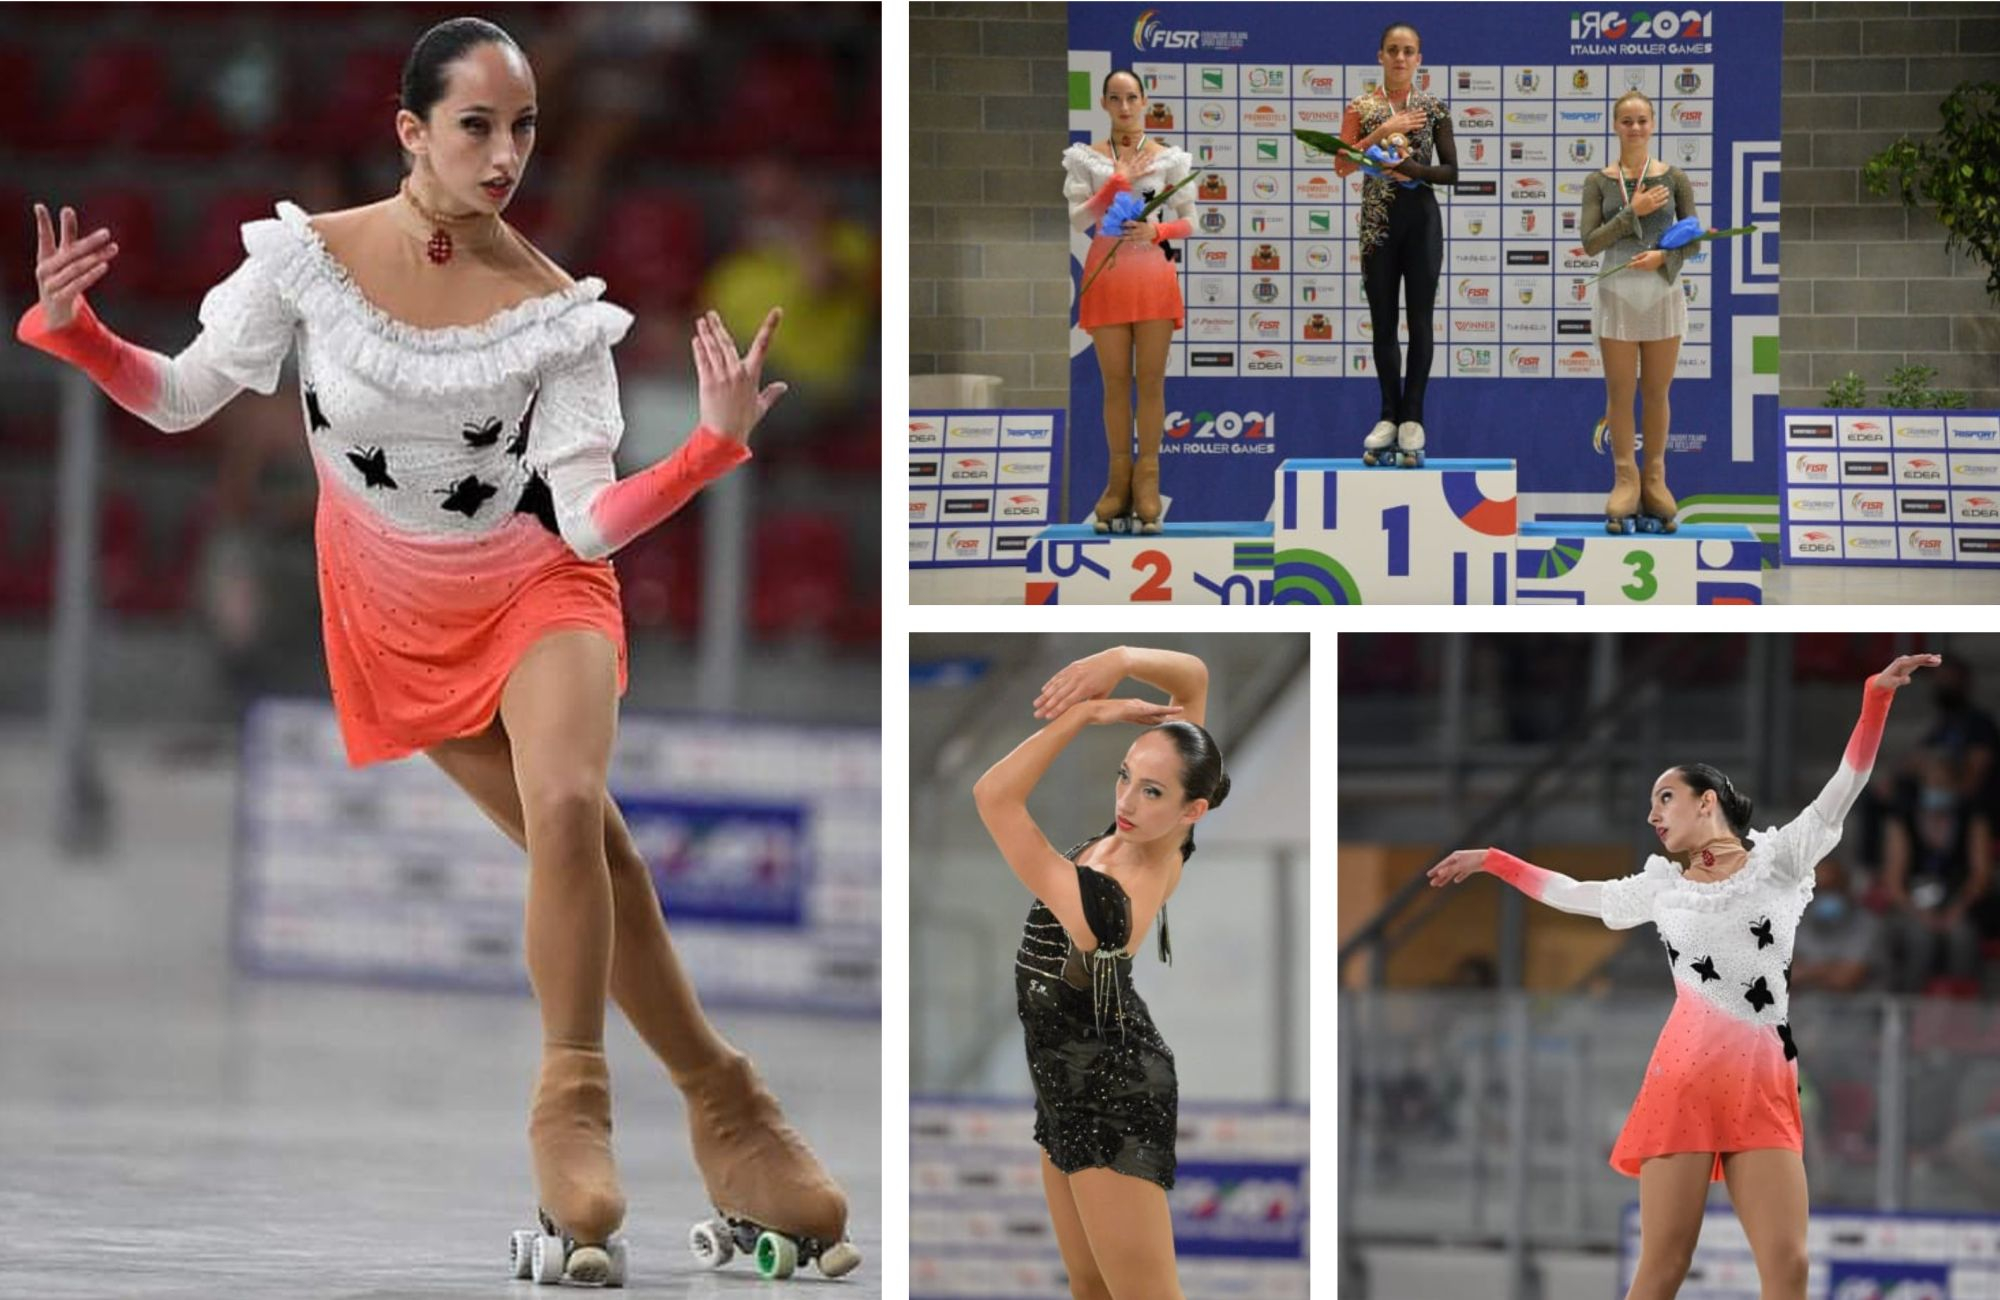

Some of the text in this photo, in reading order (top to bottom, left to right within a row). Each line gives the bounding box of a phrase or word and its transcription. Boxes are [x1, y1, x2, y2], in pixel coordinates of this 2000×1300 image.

[1630, 9, 1713, 39] 2021
[1151, 30, 1200, 48] FISR
[1570, 43, 1713, 56] ITALIAN ROLLER GAMES
[1679, 111, 1703, 122] FISR
[1458, 120, 1494, 128] EDEA
[1511, 191, 1547, 199] EDEA
[1563, 260, 1600, 269] EDEA
[1467, 288, 1490, 298] FISR
[1257, 320, 1281, 329] FISR
[1454, 320, 1496, 330] WINNER
[1248, 362, 1284, 371] EDEA
[1518, 356, 1540, 367] FISR
[1194, 410, 1275, 439] 2021
[1847, 433, 1883, 442] EDEA
[1183, 443, 1230, 454] ROLLER
[1230, 443, 1275, 454] GAMES
[1805, 463, 1828, 473] FISR
[952, 471, 988, 479] EDEA
[1903, 471, 1940, 480] EDEA
[1860, 501, 1884, 510] FISR
[1003, 506, 1040, 516] EDEA
[1961, 509, 1999, 518] EDEA
[955, 539, 979, 549] FISR
[1382, 505, 1410, 577] 1
[1918, 539, 1942, 549] FISR
[1798, 543, 1836, 553] EDEA
[1130, 549, 1173, 602] 2
[1621, 549, 1659, 602] 3
